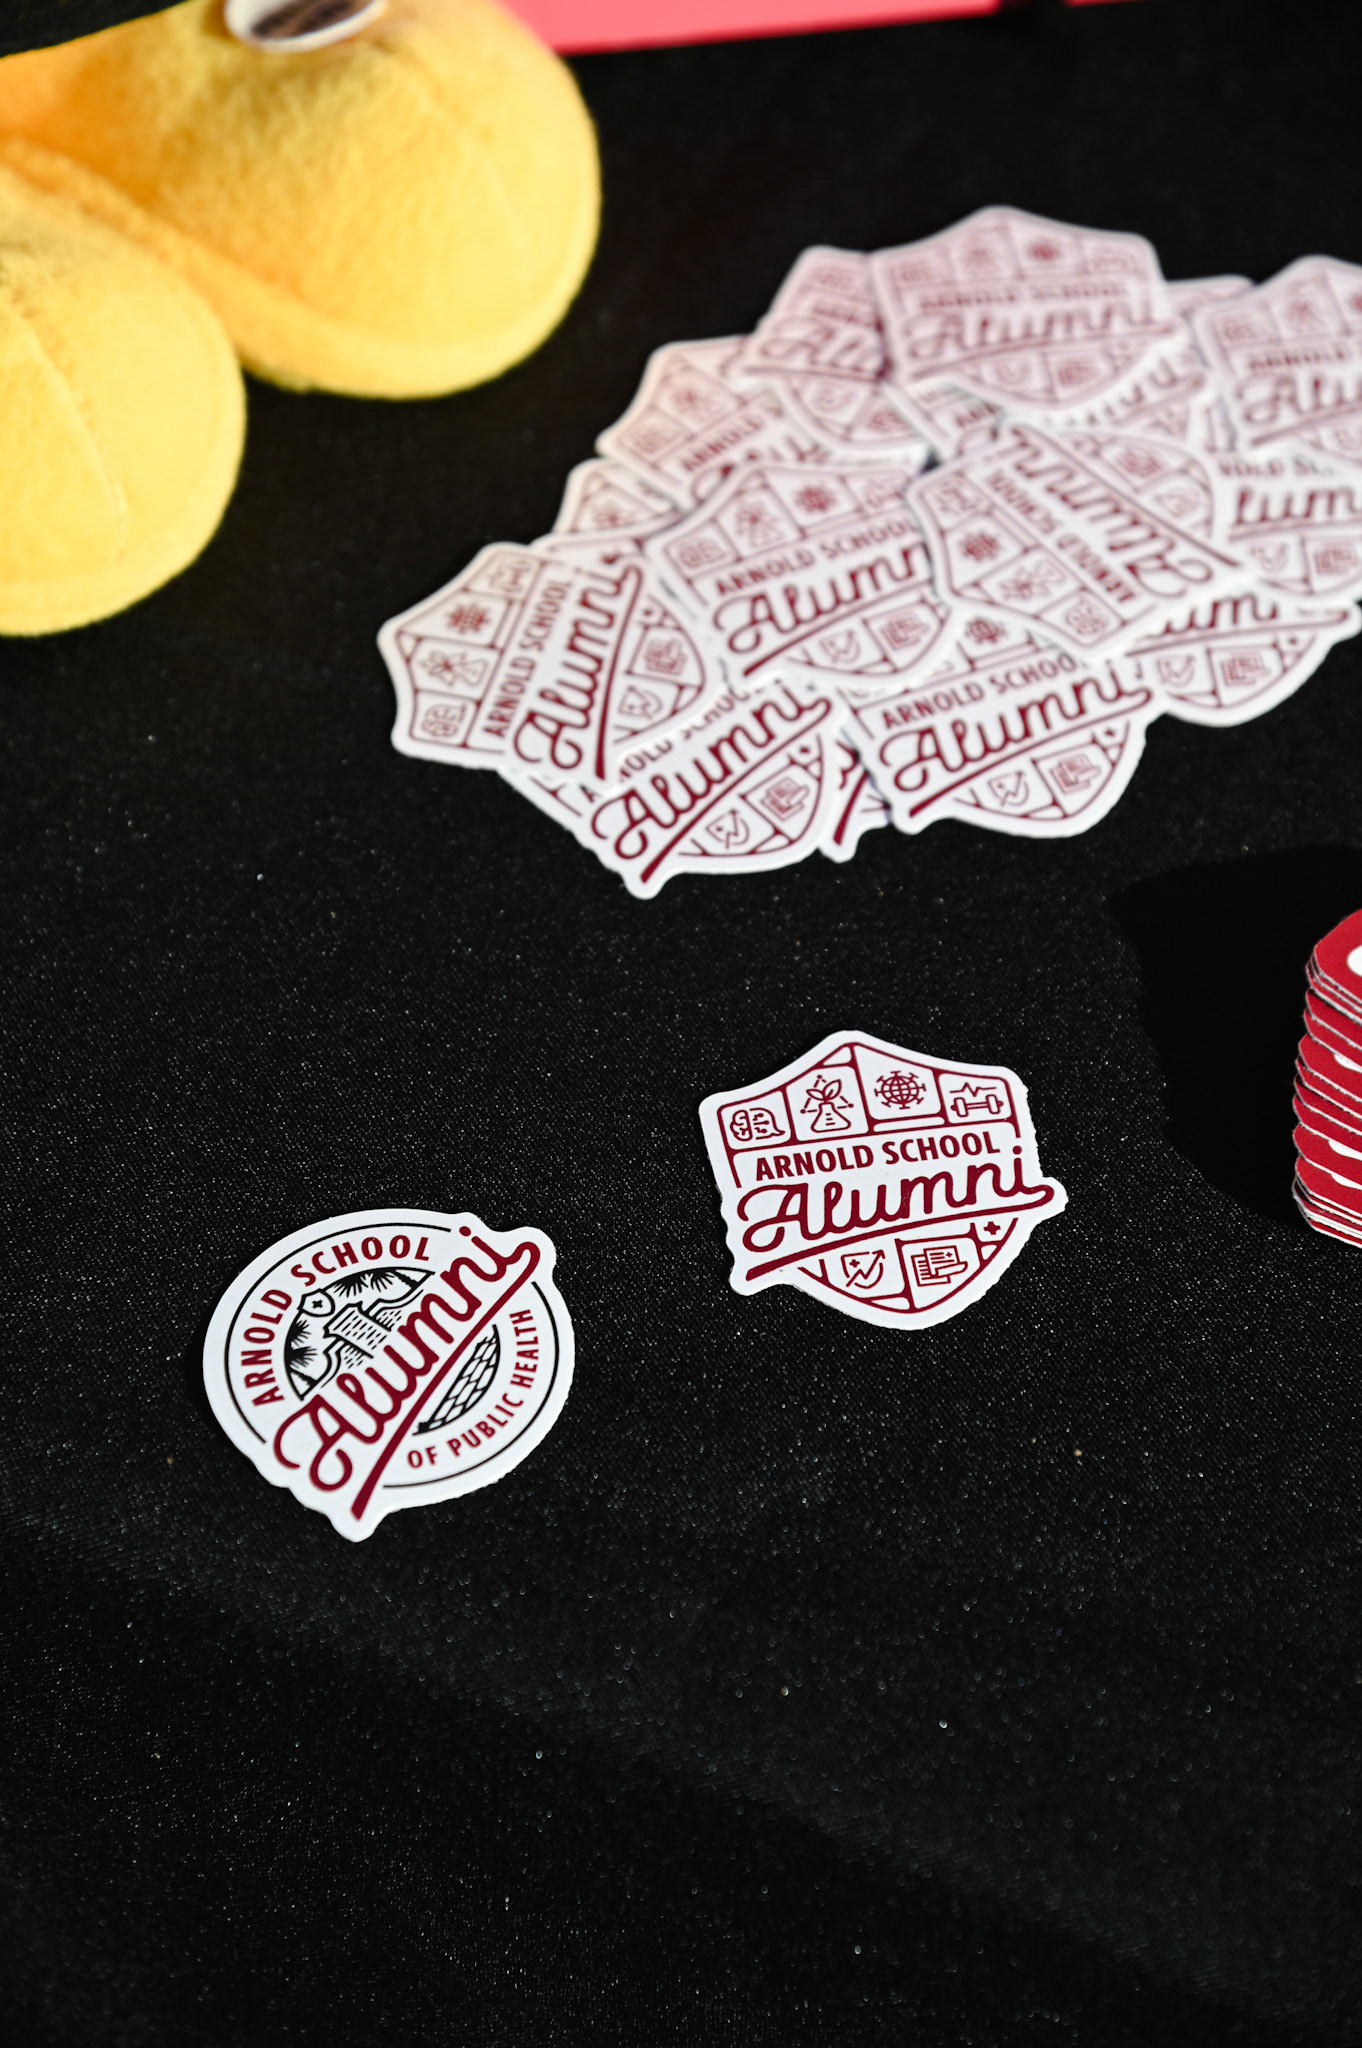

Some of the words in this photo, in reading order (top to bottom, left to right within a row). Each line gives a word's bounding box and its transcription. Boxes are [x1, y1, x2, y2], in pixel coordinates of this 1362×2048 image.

[482, 656, 537, 739] ARNOLD
[517, 578, 573, 653] SCHOOL
[512, 560, 643, 780] Alumni
[878, 657, 1153, 819] Alumni
[880, 681, 985, 730] ARNOLD
[590, 677, 832, 885] Alumni
[736, 1144, 1056, 1282] Alumni
[755, 1144, 875, 1182] ARNOLD
[884, 1130, 1001, 1166] SCHOOL
[240, 1286, 294, 1408] ARNOLD
[289, 1233, 432, 1288] SCHOOL
[272, 1224, 542, 1522] Alumni
[406, 1446, 442, 1471] OF
[445, 1391, 525, 1458] PUBLIC
[508, 1307, 541, 1391] HEALTH
